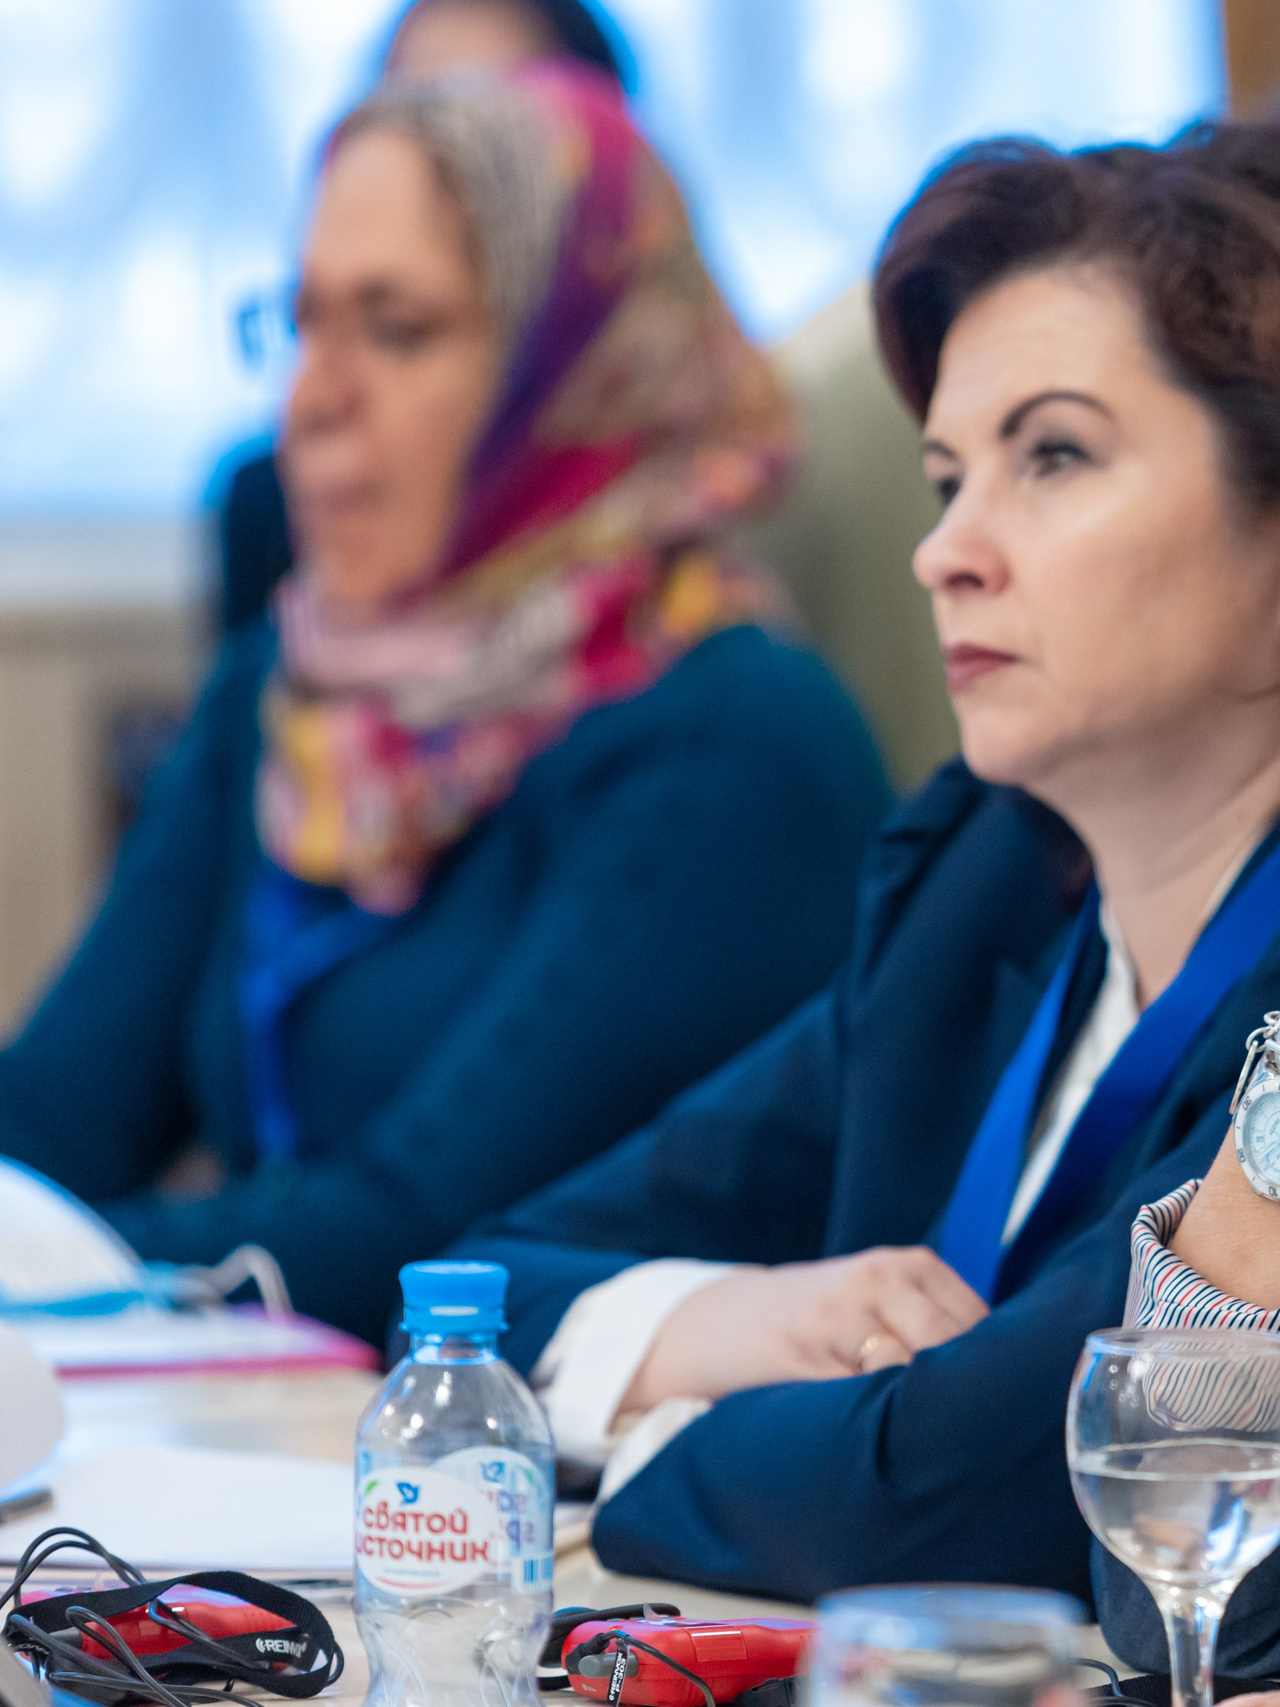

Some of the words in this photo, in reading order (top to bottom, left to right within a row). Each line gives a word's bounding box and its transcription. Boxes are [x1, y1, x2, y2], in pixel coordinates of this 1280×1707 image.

[1242, 1096, 1252, 1111] 30
[1237, 1148, 1246, 1163] 20
[1268, 1186, 1278, 1197] 10
